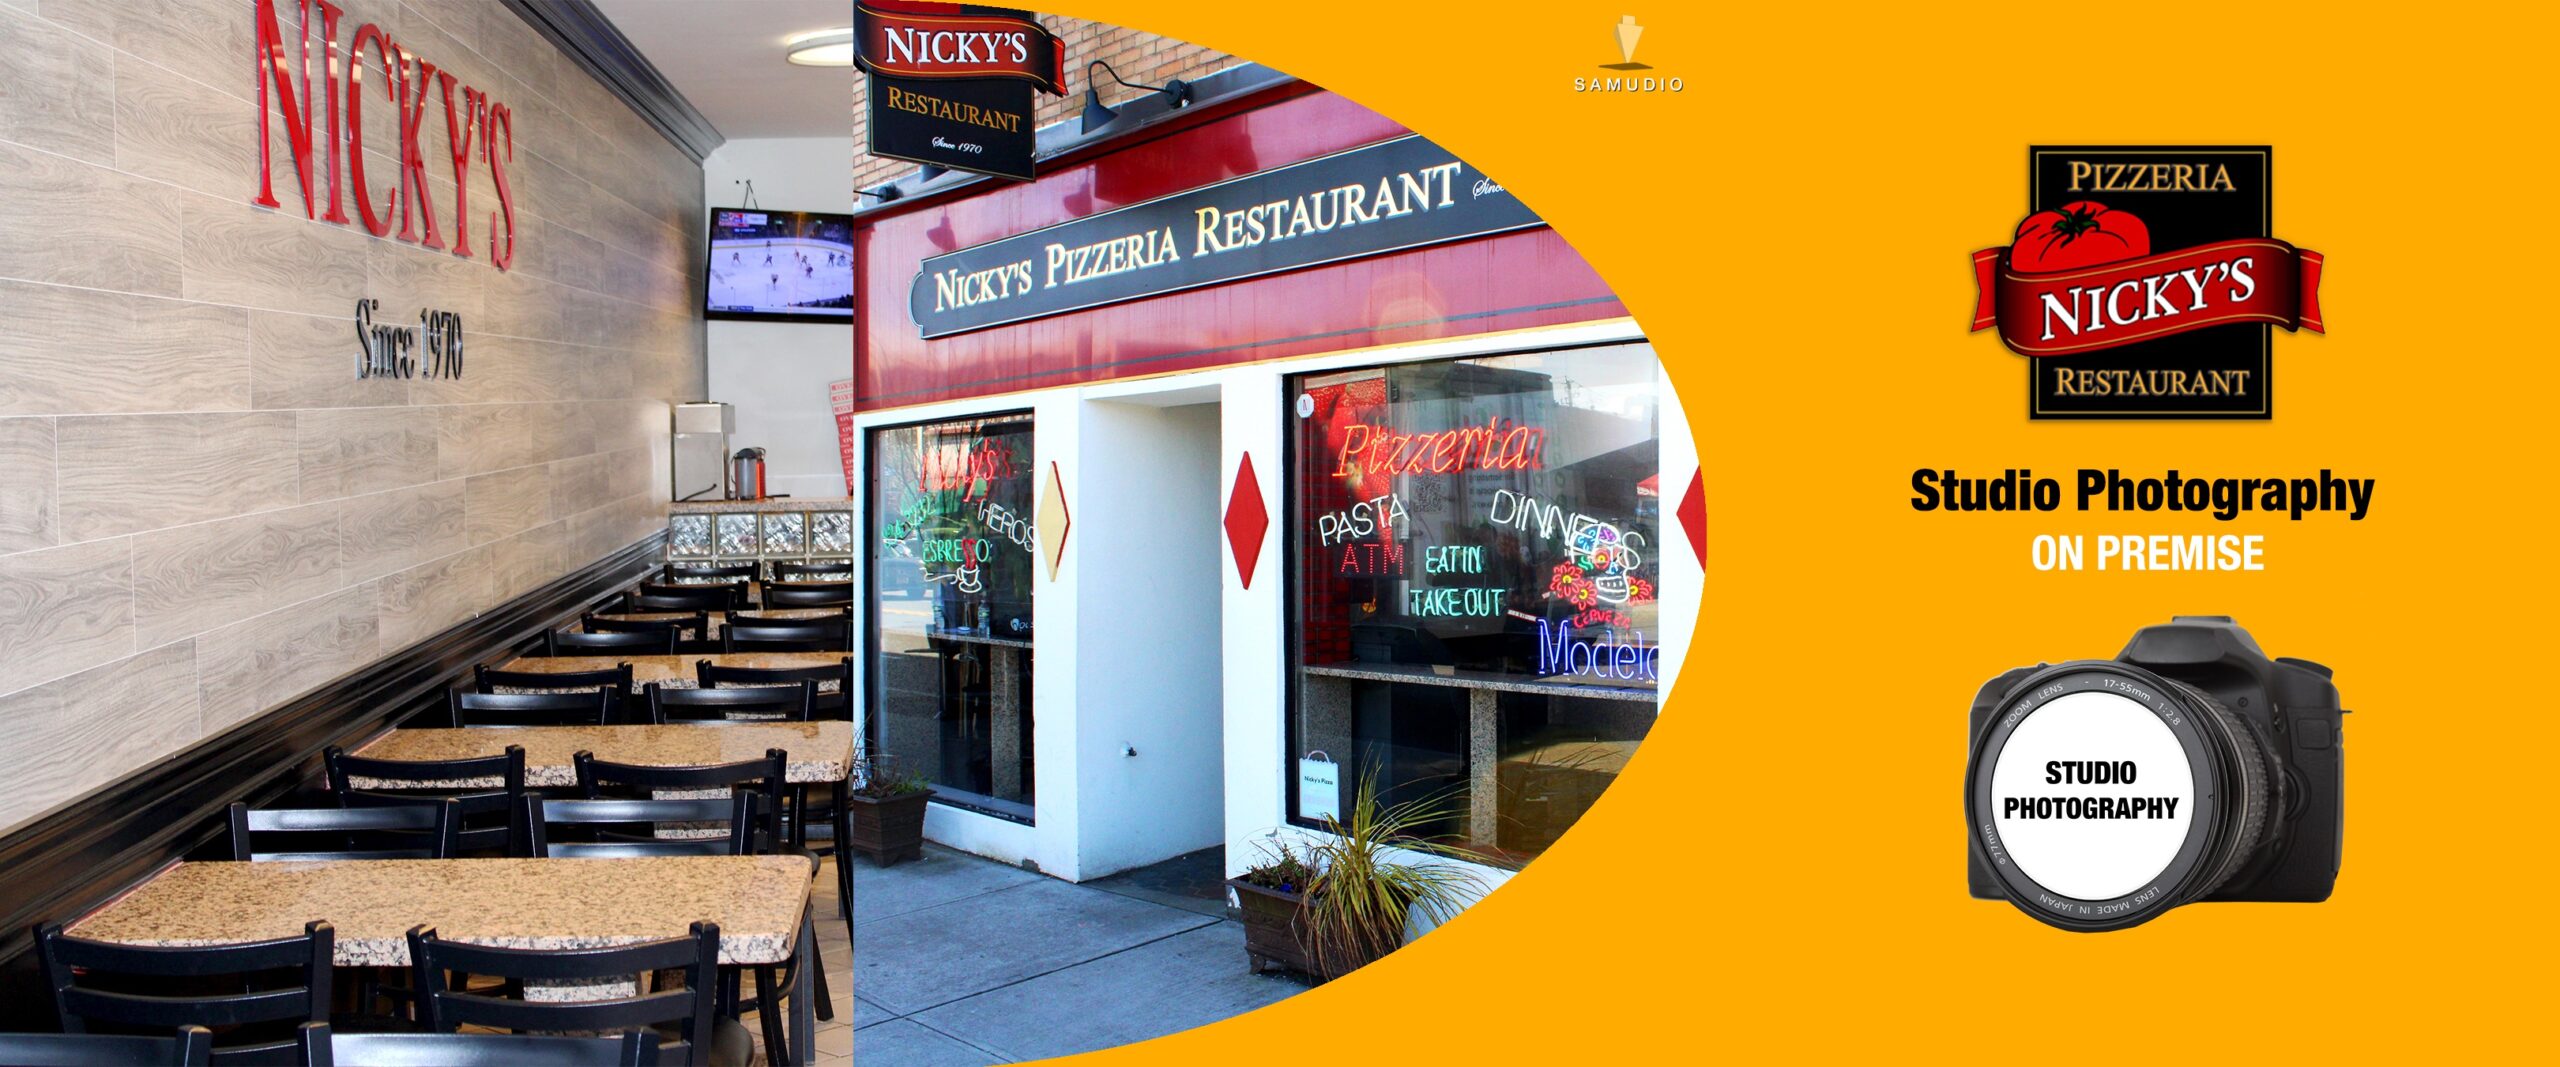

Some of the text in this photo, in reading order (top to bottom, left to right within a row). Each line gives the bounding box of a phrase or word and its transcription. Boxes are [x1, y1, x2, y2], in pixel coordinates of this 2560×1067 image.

[884, 27, 1029, 64] NICKY'S
[887, 86, 1021, 133] RESTAURANT
[254, 0, 515, 272] NICKY'S
[931, 136, 983, 154] Since 1970
[934, 260, 1032, 313] NICKY'S
[1045, 227, 1179, 288] PIZZERIA
[1193, 161, 1461, 258] RESTAURANT
[355, 298, 464, 381] Since 1970
[1331, 416, 1532, 477] Pizzeria
[977, 499, 1035, 553] HEROS
[1319, 493, 1411, 547] PASTA
[1490, 489, 1646, 571] DINNERS
[1340, 543, 1404, 575] ATM
[1410, 589, 1460, 616] TAKE
[1464, 588, 1505, 617] OUT
[2003, 700, 2032, 728] ZOOM
[2038, 682, 2064, 700] LENS
[2104, 678, 2151, 702] 17-55mm
[2157, 702, 2181, 726] 1:2.8
[2039, 886, 2160, 915] LENS MADE IN JAPAN
